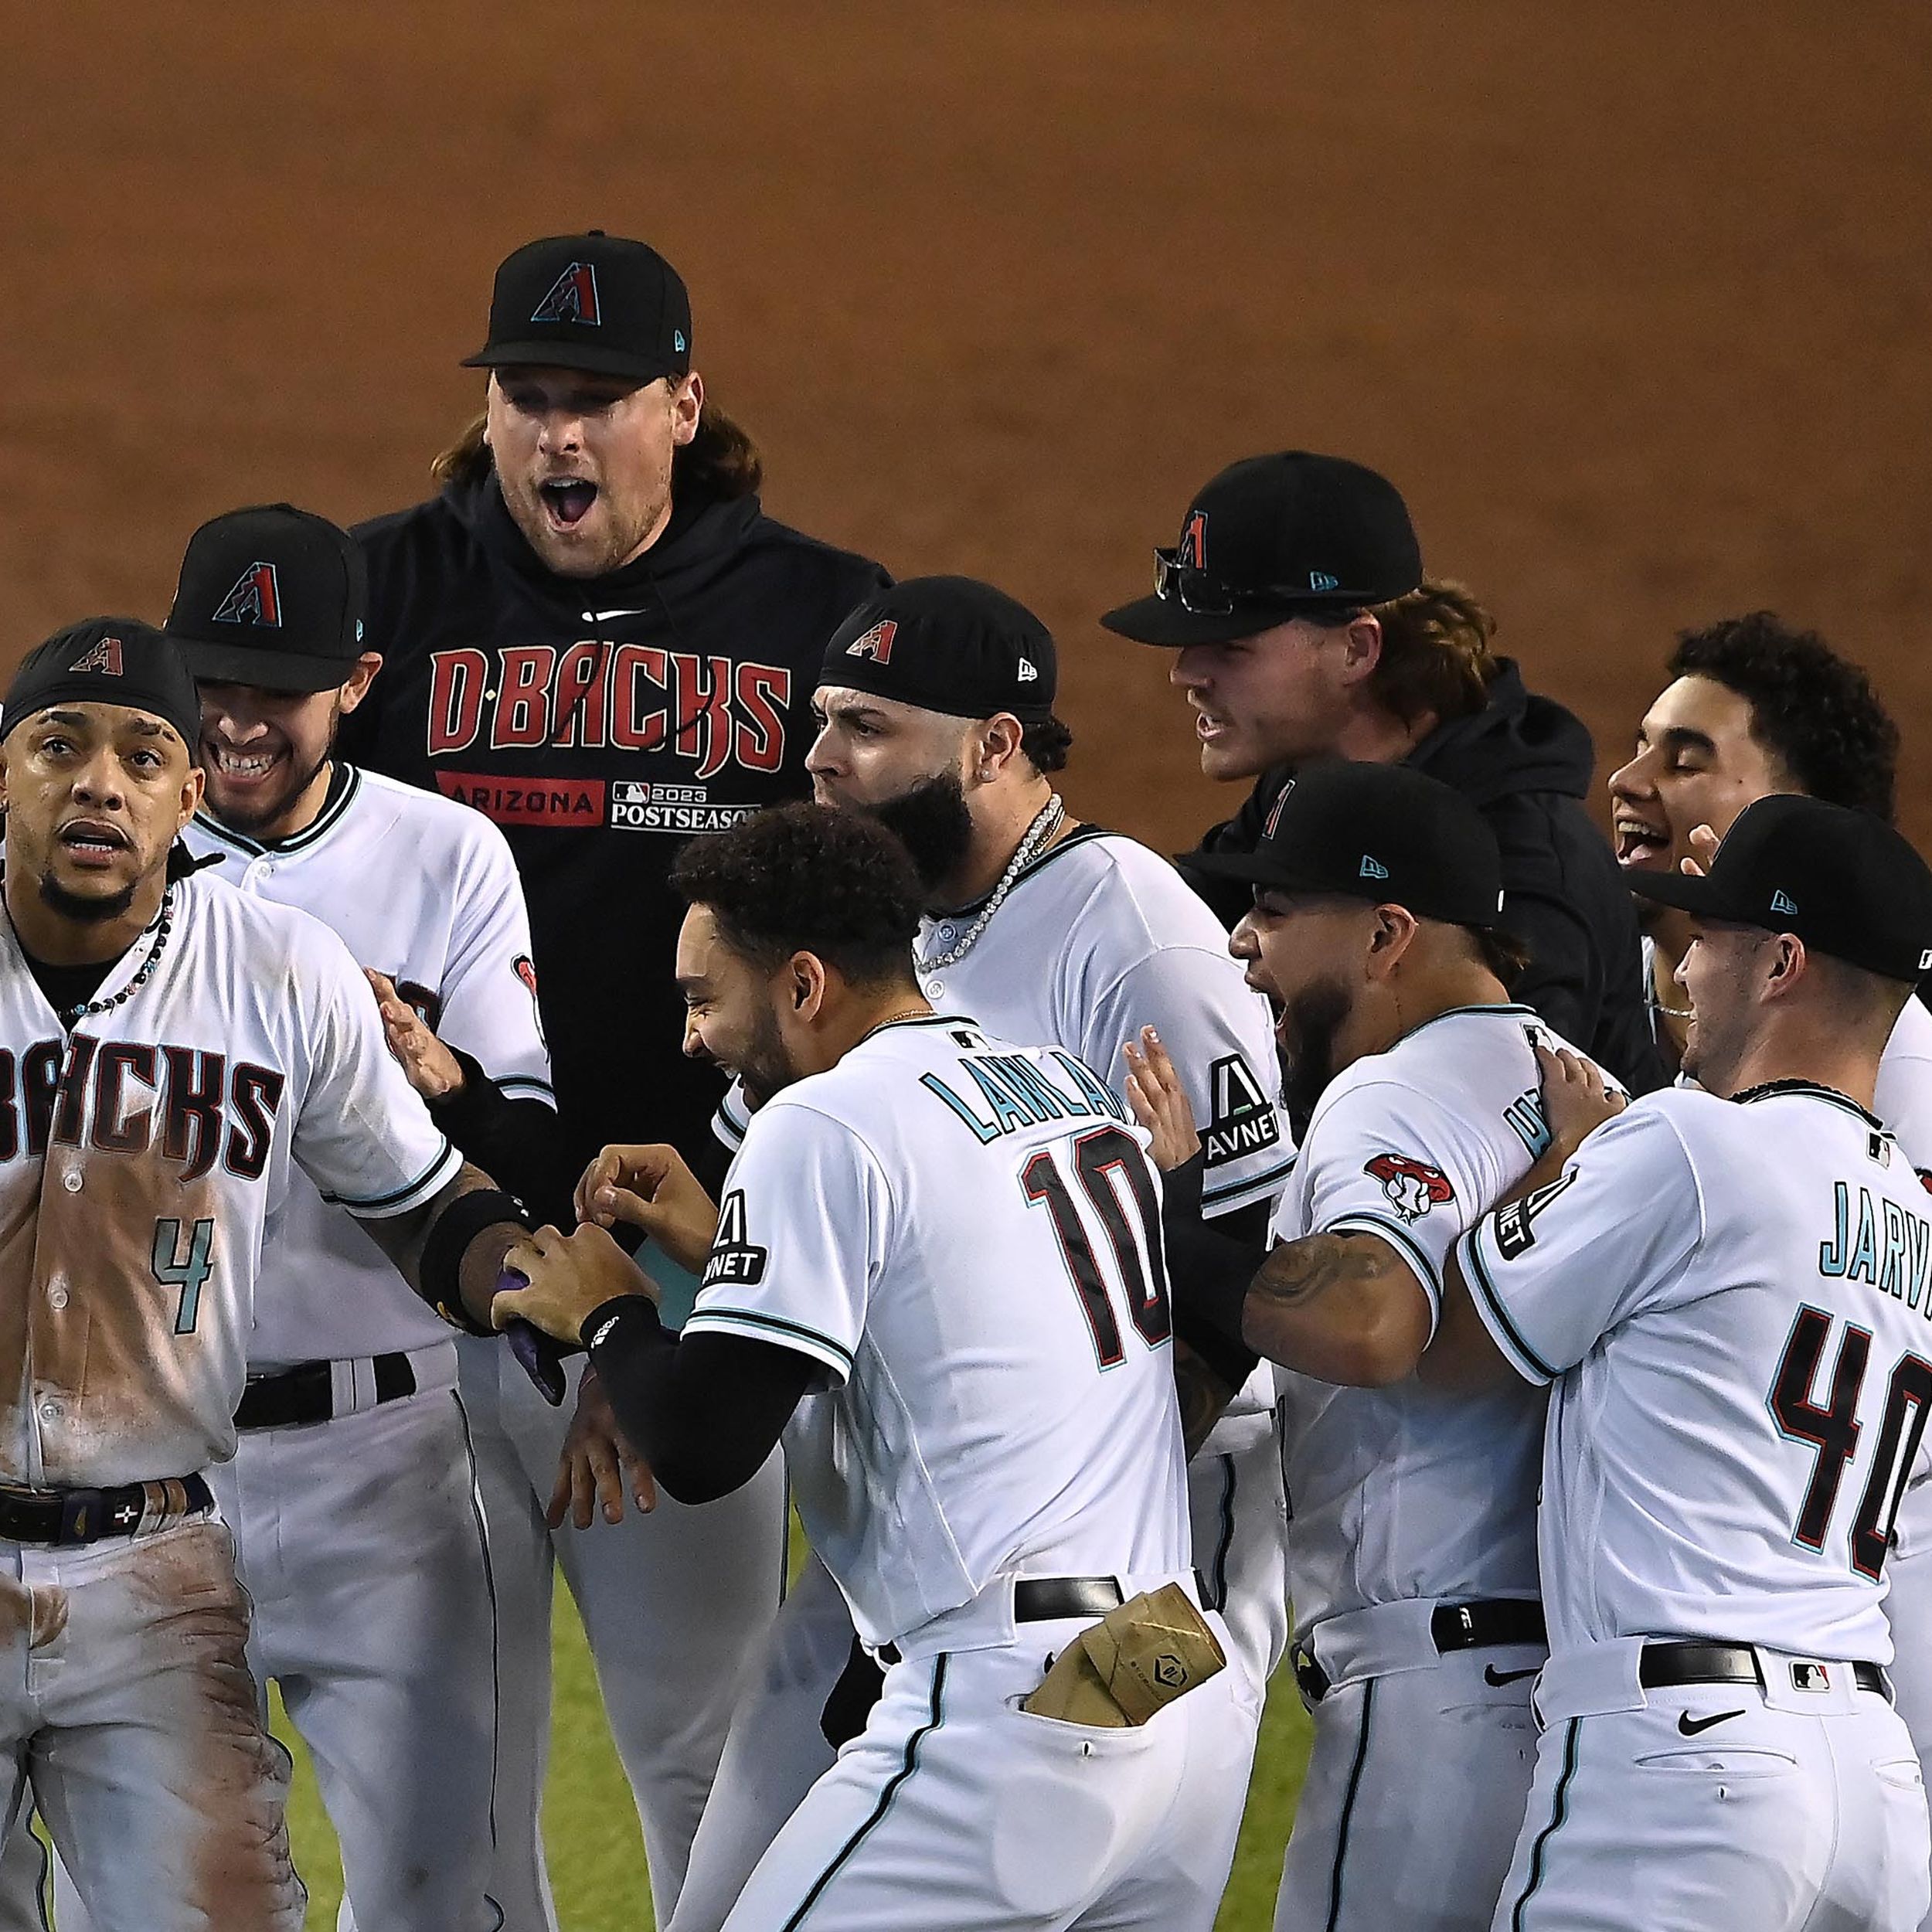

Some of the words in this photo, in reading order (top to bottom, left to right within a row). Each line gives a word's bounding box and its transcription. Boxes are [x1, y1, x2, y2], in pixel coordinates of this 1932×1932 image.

[451, 784, 594, 815] ARIZONA
[611, 802, 761, 830] POSTSEASO
[651, 787, 707, 803] 2023
[917, 1049, 1134, 1146] LAWLA
[151, 1216, 216, 1335] 4
[1015, 1122, 1172, 1374] 10
[1819, 1181, 1932, 1322] JARV
[1764, 1301, 1932, 1587] 40
